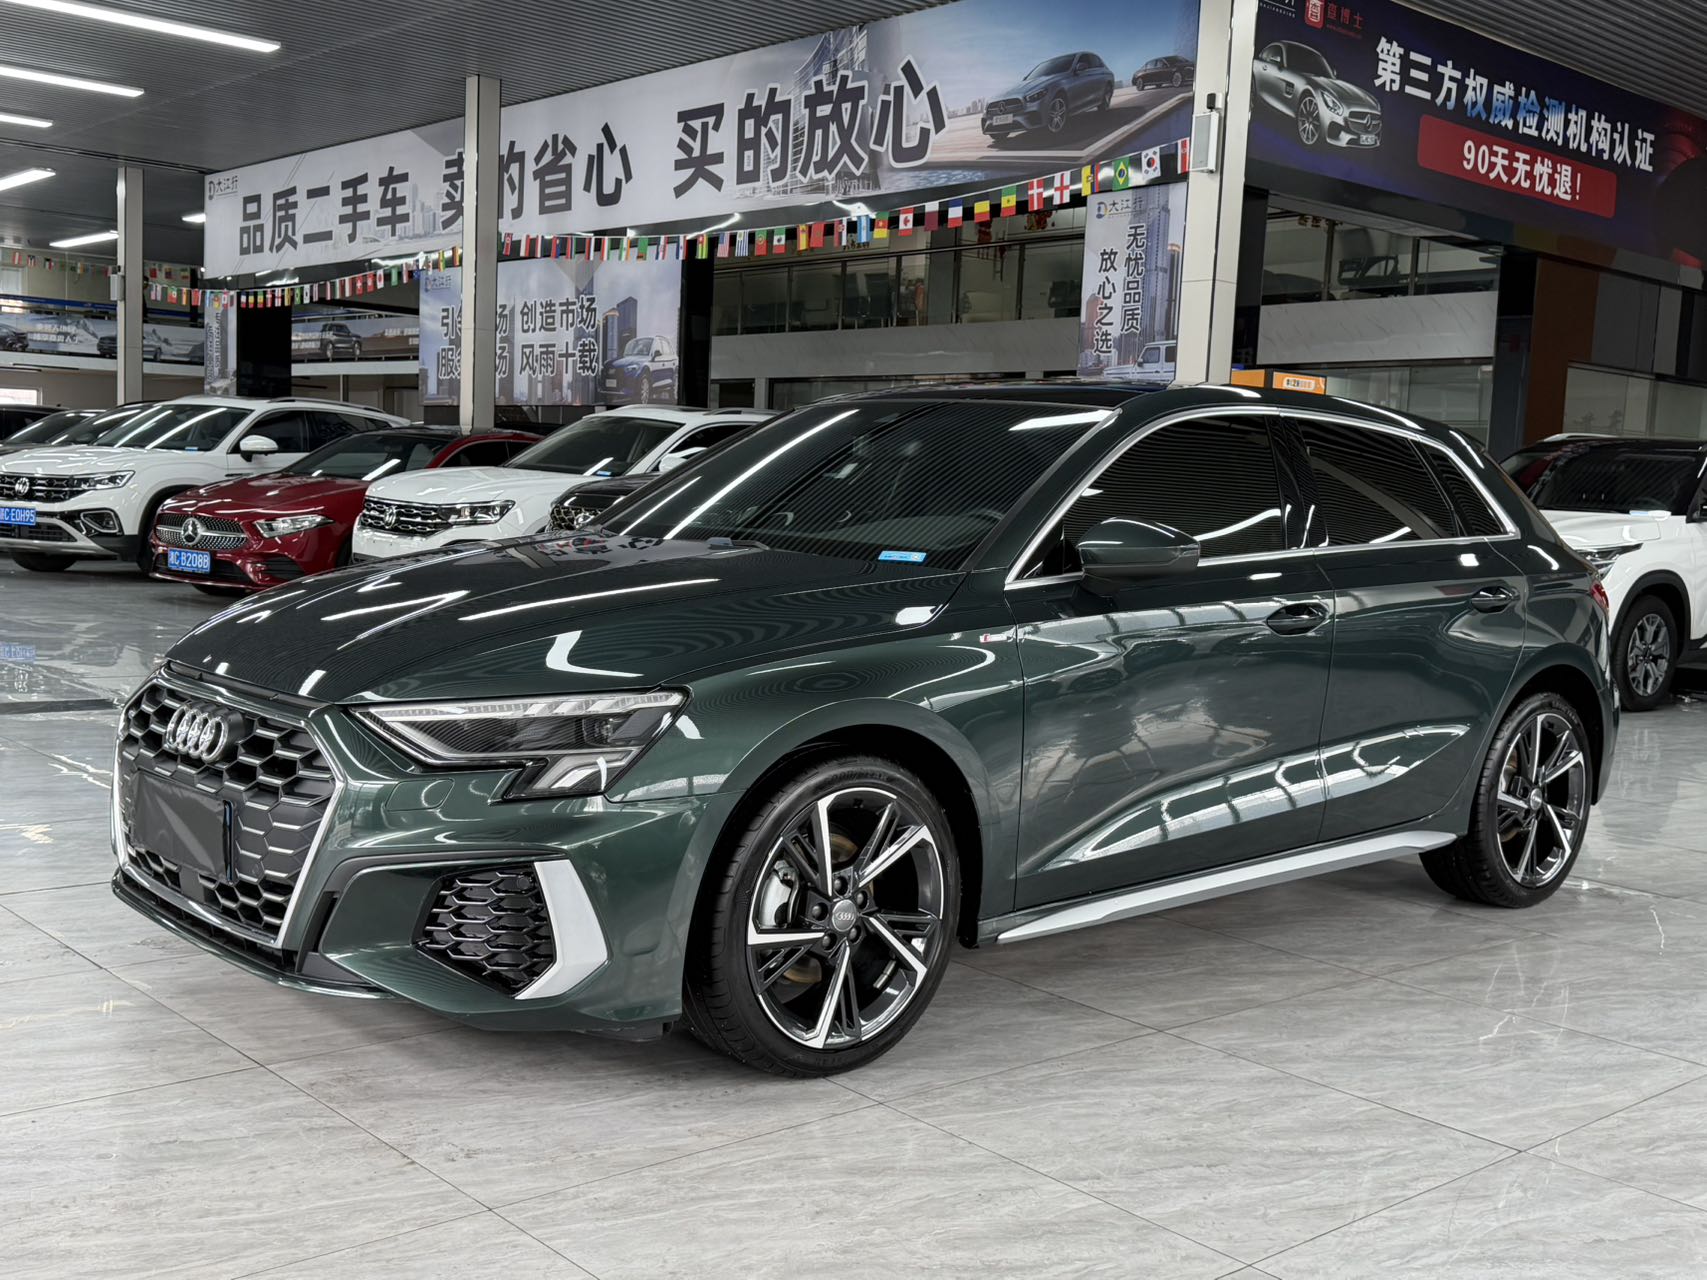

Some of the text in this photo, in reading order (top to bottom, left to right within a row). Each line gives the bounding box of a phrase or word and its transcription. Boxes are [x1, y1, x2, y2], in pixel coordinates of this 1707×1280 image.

[239, 165, 410, 256] 品质二手车
[673, 58, 946, 199] 买的放心
[1373, 36, 1656, 173] 第三方权威检测机构认证
[1108, 196, 1144, 212] 大江行
[519, 295, 598, 334] 创造市场
[1093, 248, 1119, 355] 放心之选
[1121, 225, 1146, 332] 无忧品质
[519, 338, 598, 377] 风雨十载
